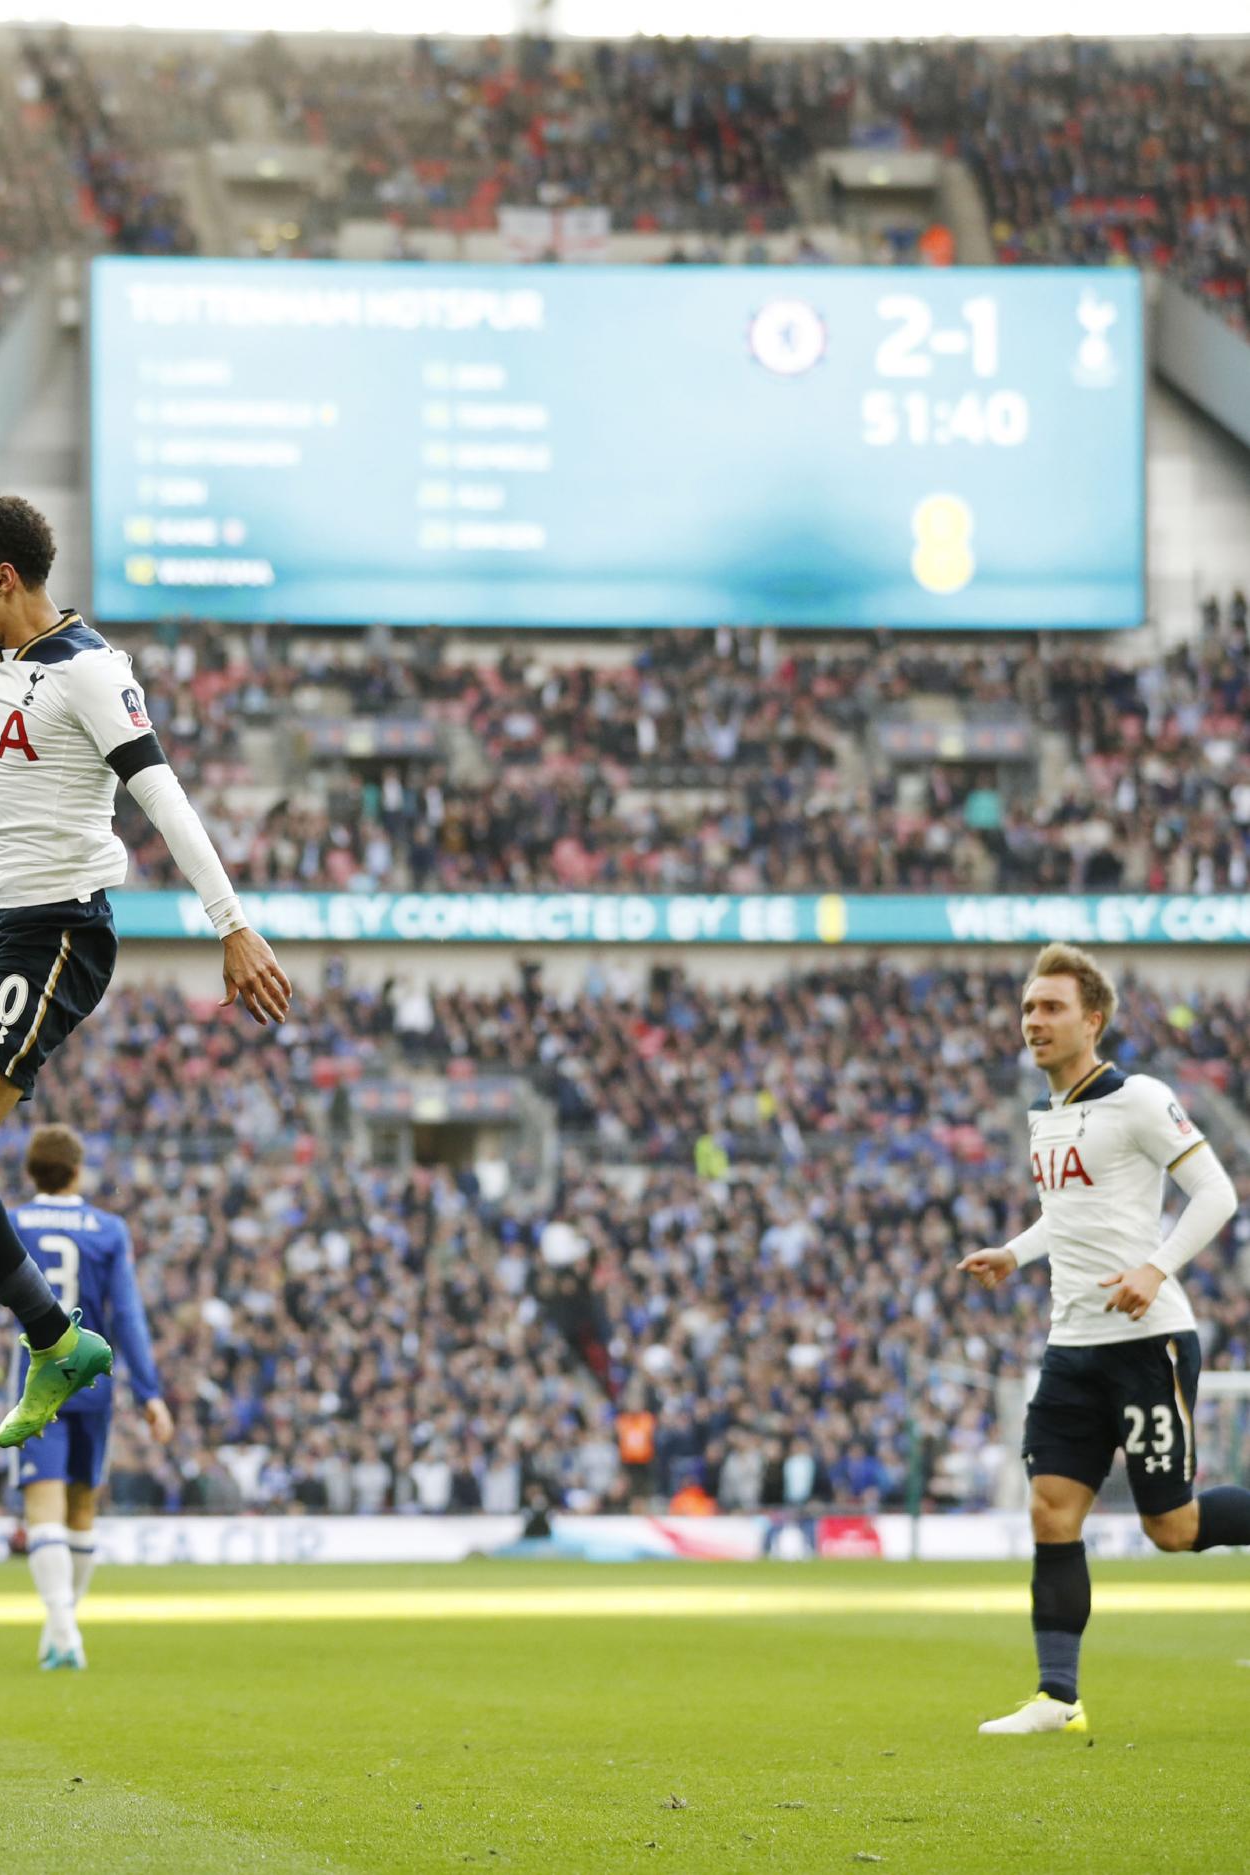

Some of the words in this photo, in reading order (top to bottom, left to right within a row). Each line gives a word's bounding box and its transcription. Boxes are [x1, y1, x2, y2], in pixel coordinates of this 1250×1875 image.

[365, 288, 544, 330] HOTSPUR
[874, 294, 999, 378] 2-1
[861, 390, 1030, 447] 51:40
[177, 893, 393, 939] WMBLEY
[392, 893, 657, 941] CONNECTED
[666, 894, 729, 942] BY
[738, 894, 798, 942] EE
[945, 895, 1158, 943] WEMBLEY
[38, 1235, 80, 1318] 3
[1124, 1405, 1174, 1454] 23
[218, 1523, 327, 1562] CUP
